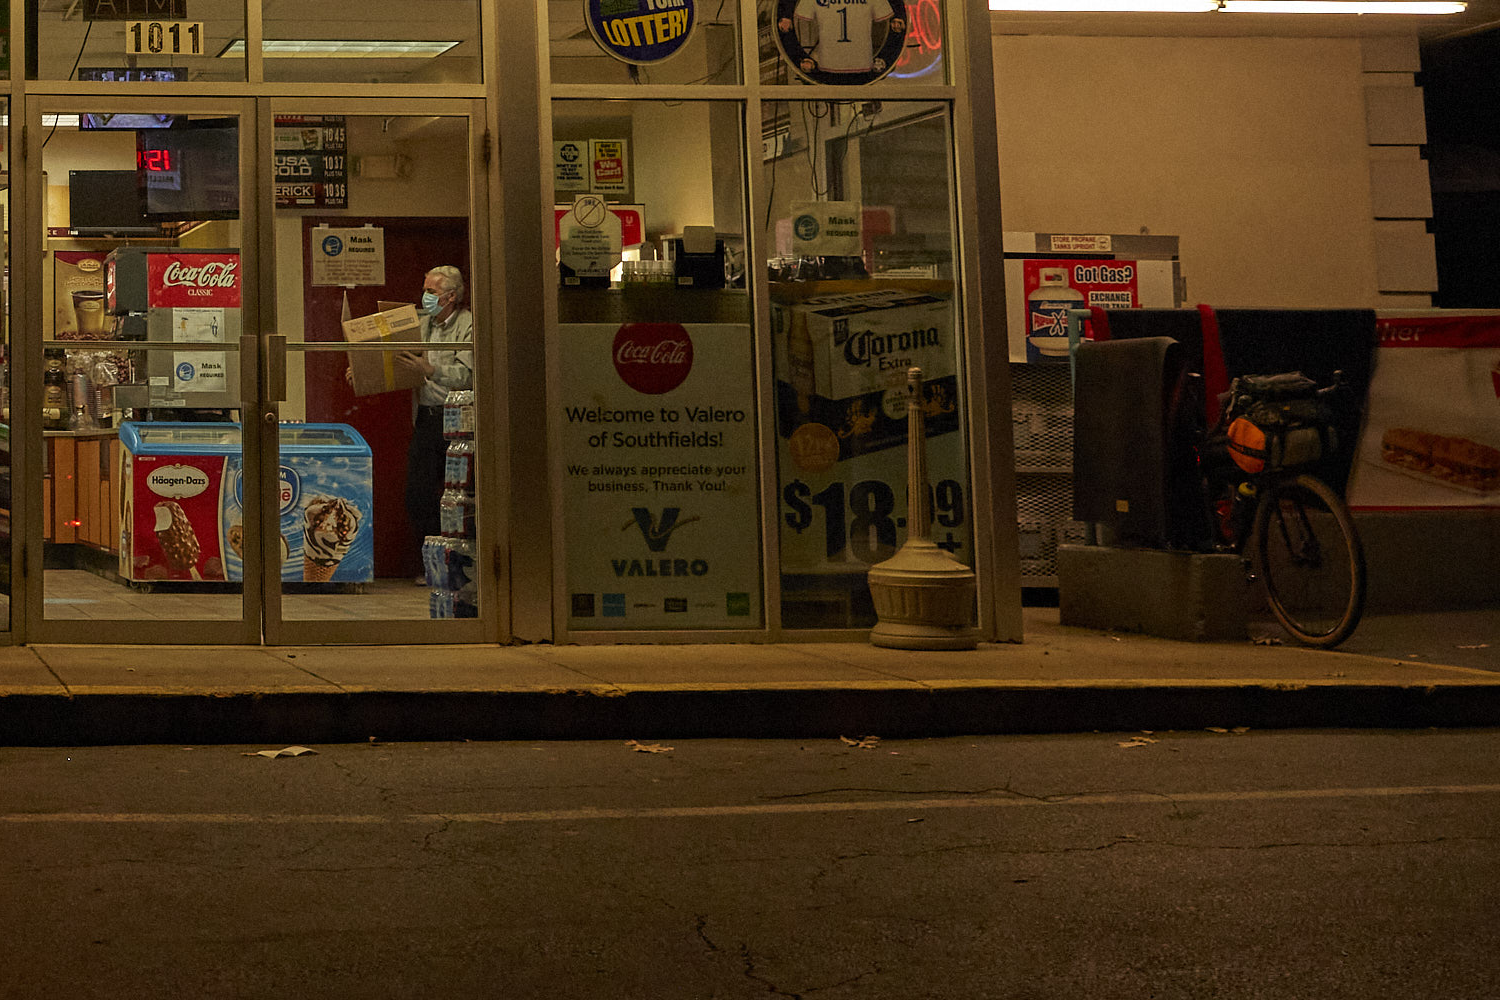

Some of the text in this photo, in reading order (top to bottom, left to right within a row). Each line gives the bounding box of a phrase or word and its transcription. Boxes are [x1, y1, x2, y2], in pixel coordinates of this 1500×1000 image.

[602, 8, 689, 47] LOTTERY
[836, 6, 852, 43] 1
[131, 22, 200, 53] 1011
[275, 156, 310, 166] USA
[828, 216, 856, 225] Mask
[162, 261, 239, 288] Coca-Cola
[1075, 266, 1133, 284] Got Gas?
[187, 289, 213, 297] CLASSIC
[1090, 293, 1131, 302] EXCHANGE
[617, 340, 688, 364] Coca-Cola
[844, 327, 939, 366] Corona
[879, 357, 912, 371] Extra
[566, 407, 746, 423] Welcome to Valero
[588, 432, 723, 448] of Southfields!
[568, 464, 747, 478] We always appreciate your
[152, 475, 206, 488] Häagen-Dazs
[588, 480, 727, 494] business, Thank You!
[784, 479, 964, 563] $18.9
[611, 559, 709, 577] VALERO
